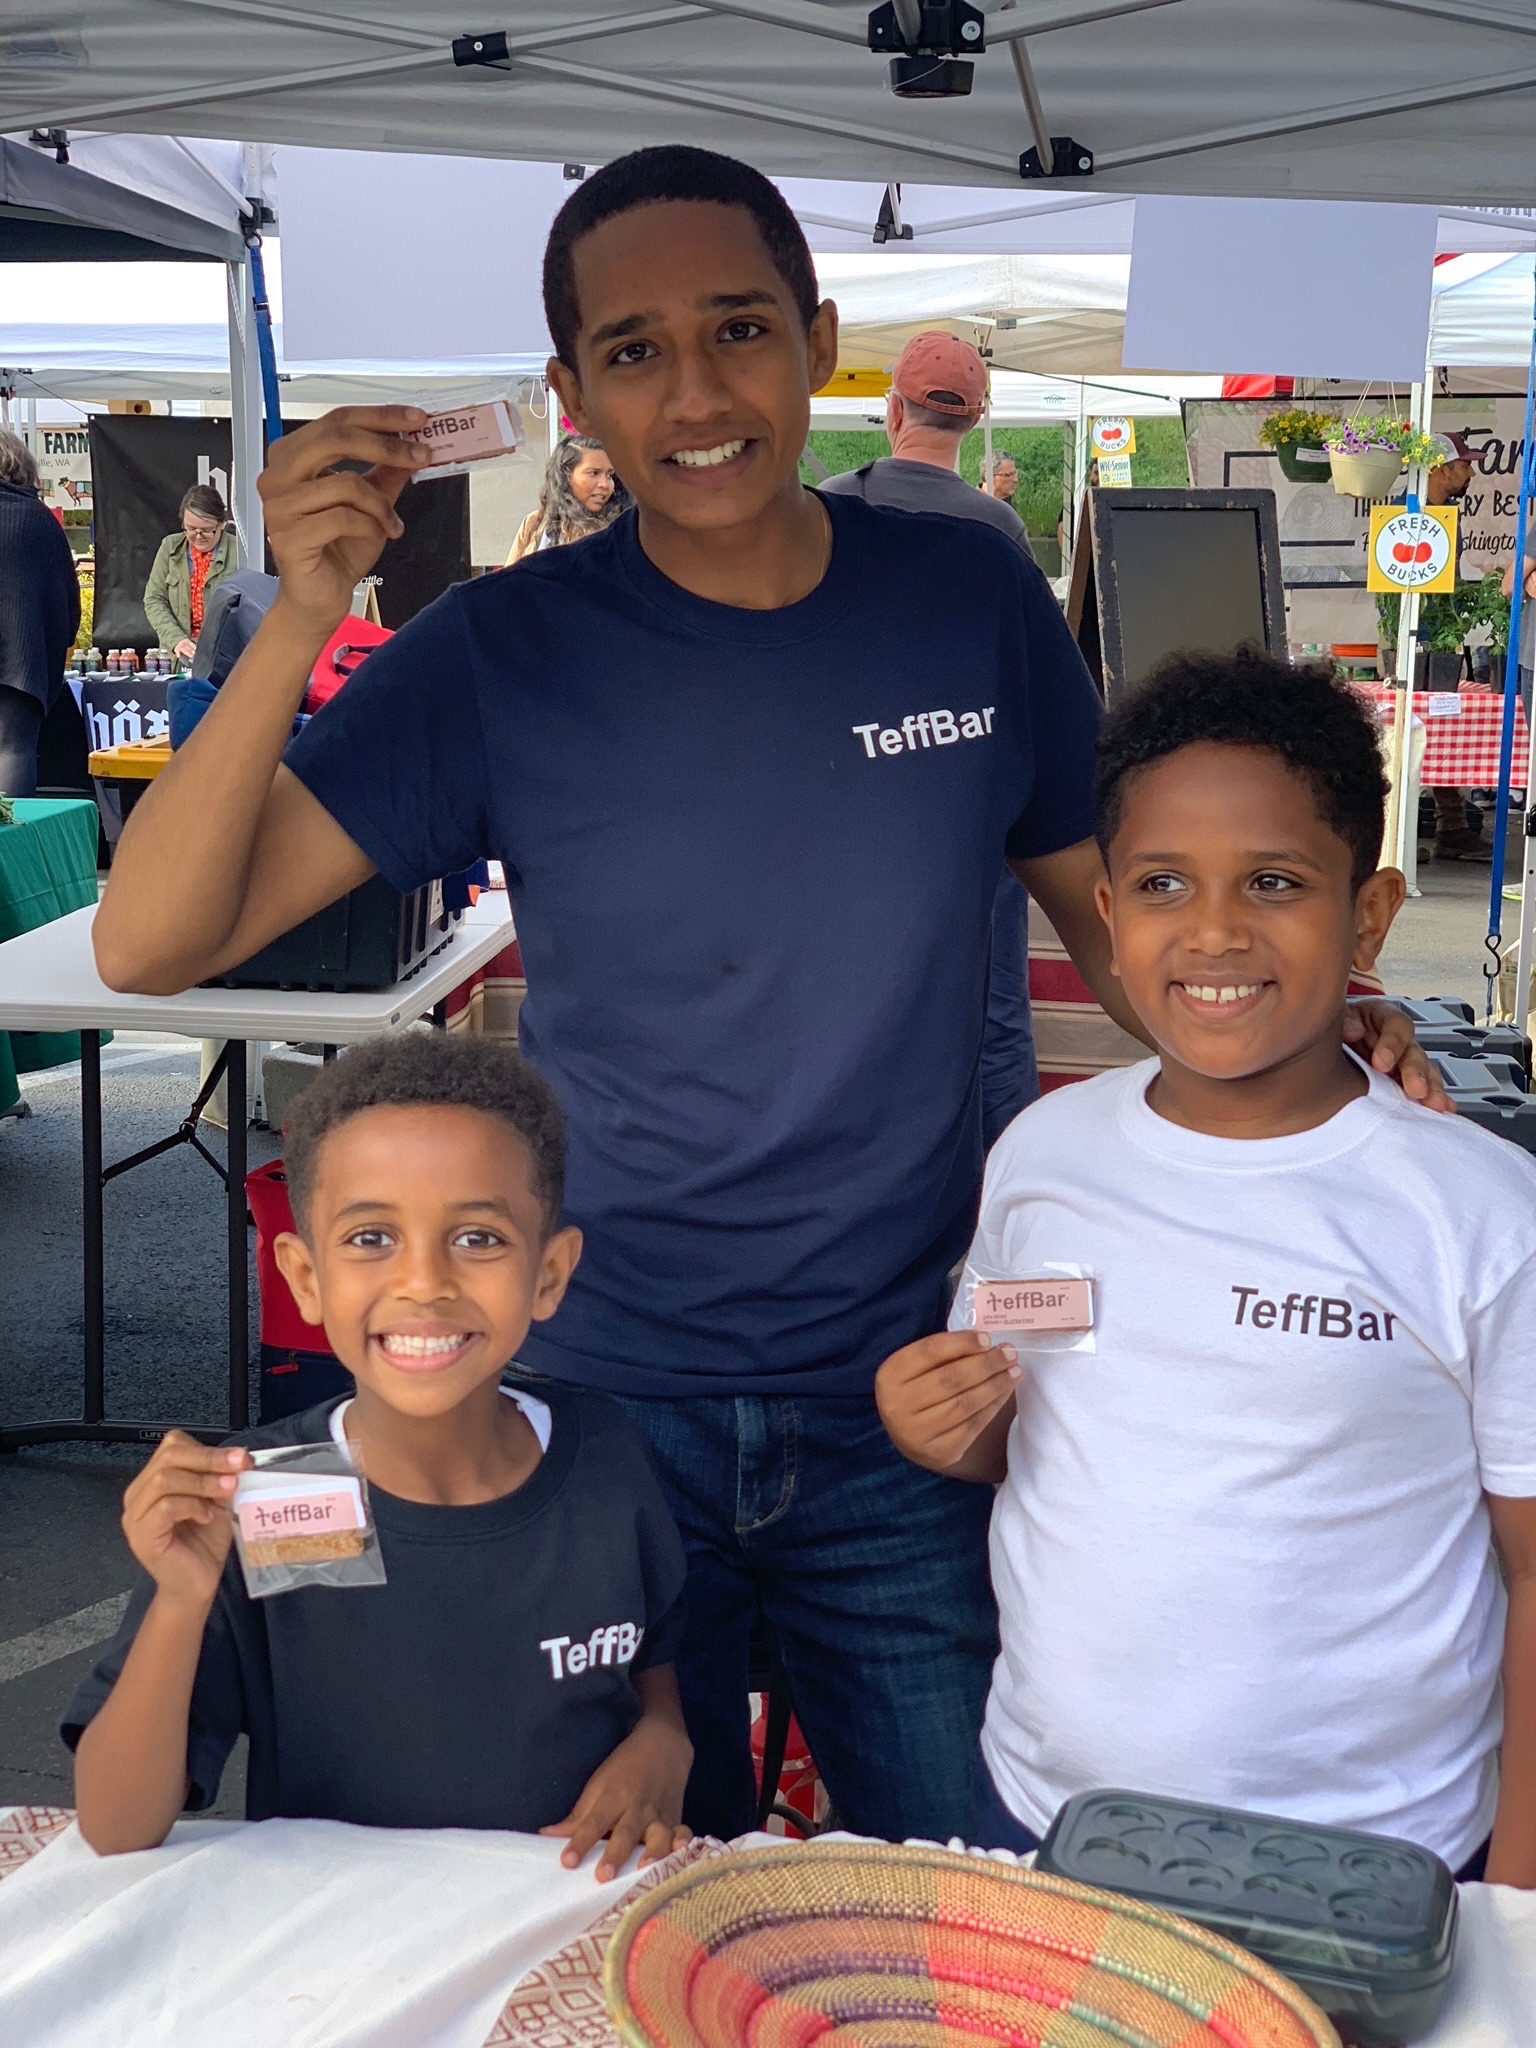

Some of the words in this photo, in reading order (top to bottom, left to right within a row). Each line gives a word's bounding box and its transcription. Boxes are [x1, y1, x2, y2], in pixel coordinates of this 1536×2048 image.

[1097, 416, 1125, 427] FRESH
[1100, 438, 1126, 449] BUCKS
[39, 458, 54, 468] ille,
[55, 459, 71, 467] WA
[1388, 517, 1441, 538] FRESH
[1462, 531, 1516, 555] shingto
[360, 575, 384, 586] attle
[1386, 562, 1438, 582] BUCKS
[852, 706, 996, 758] TeffBar
[1231, 1285, 1399, 1342] TeffBar
[539, 1621, 645, 1680] TeffB
